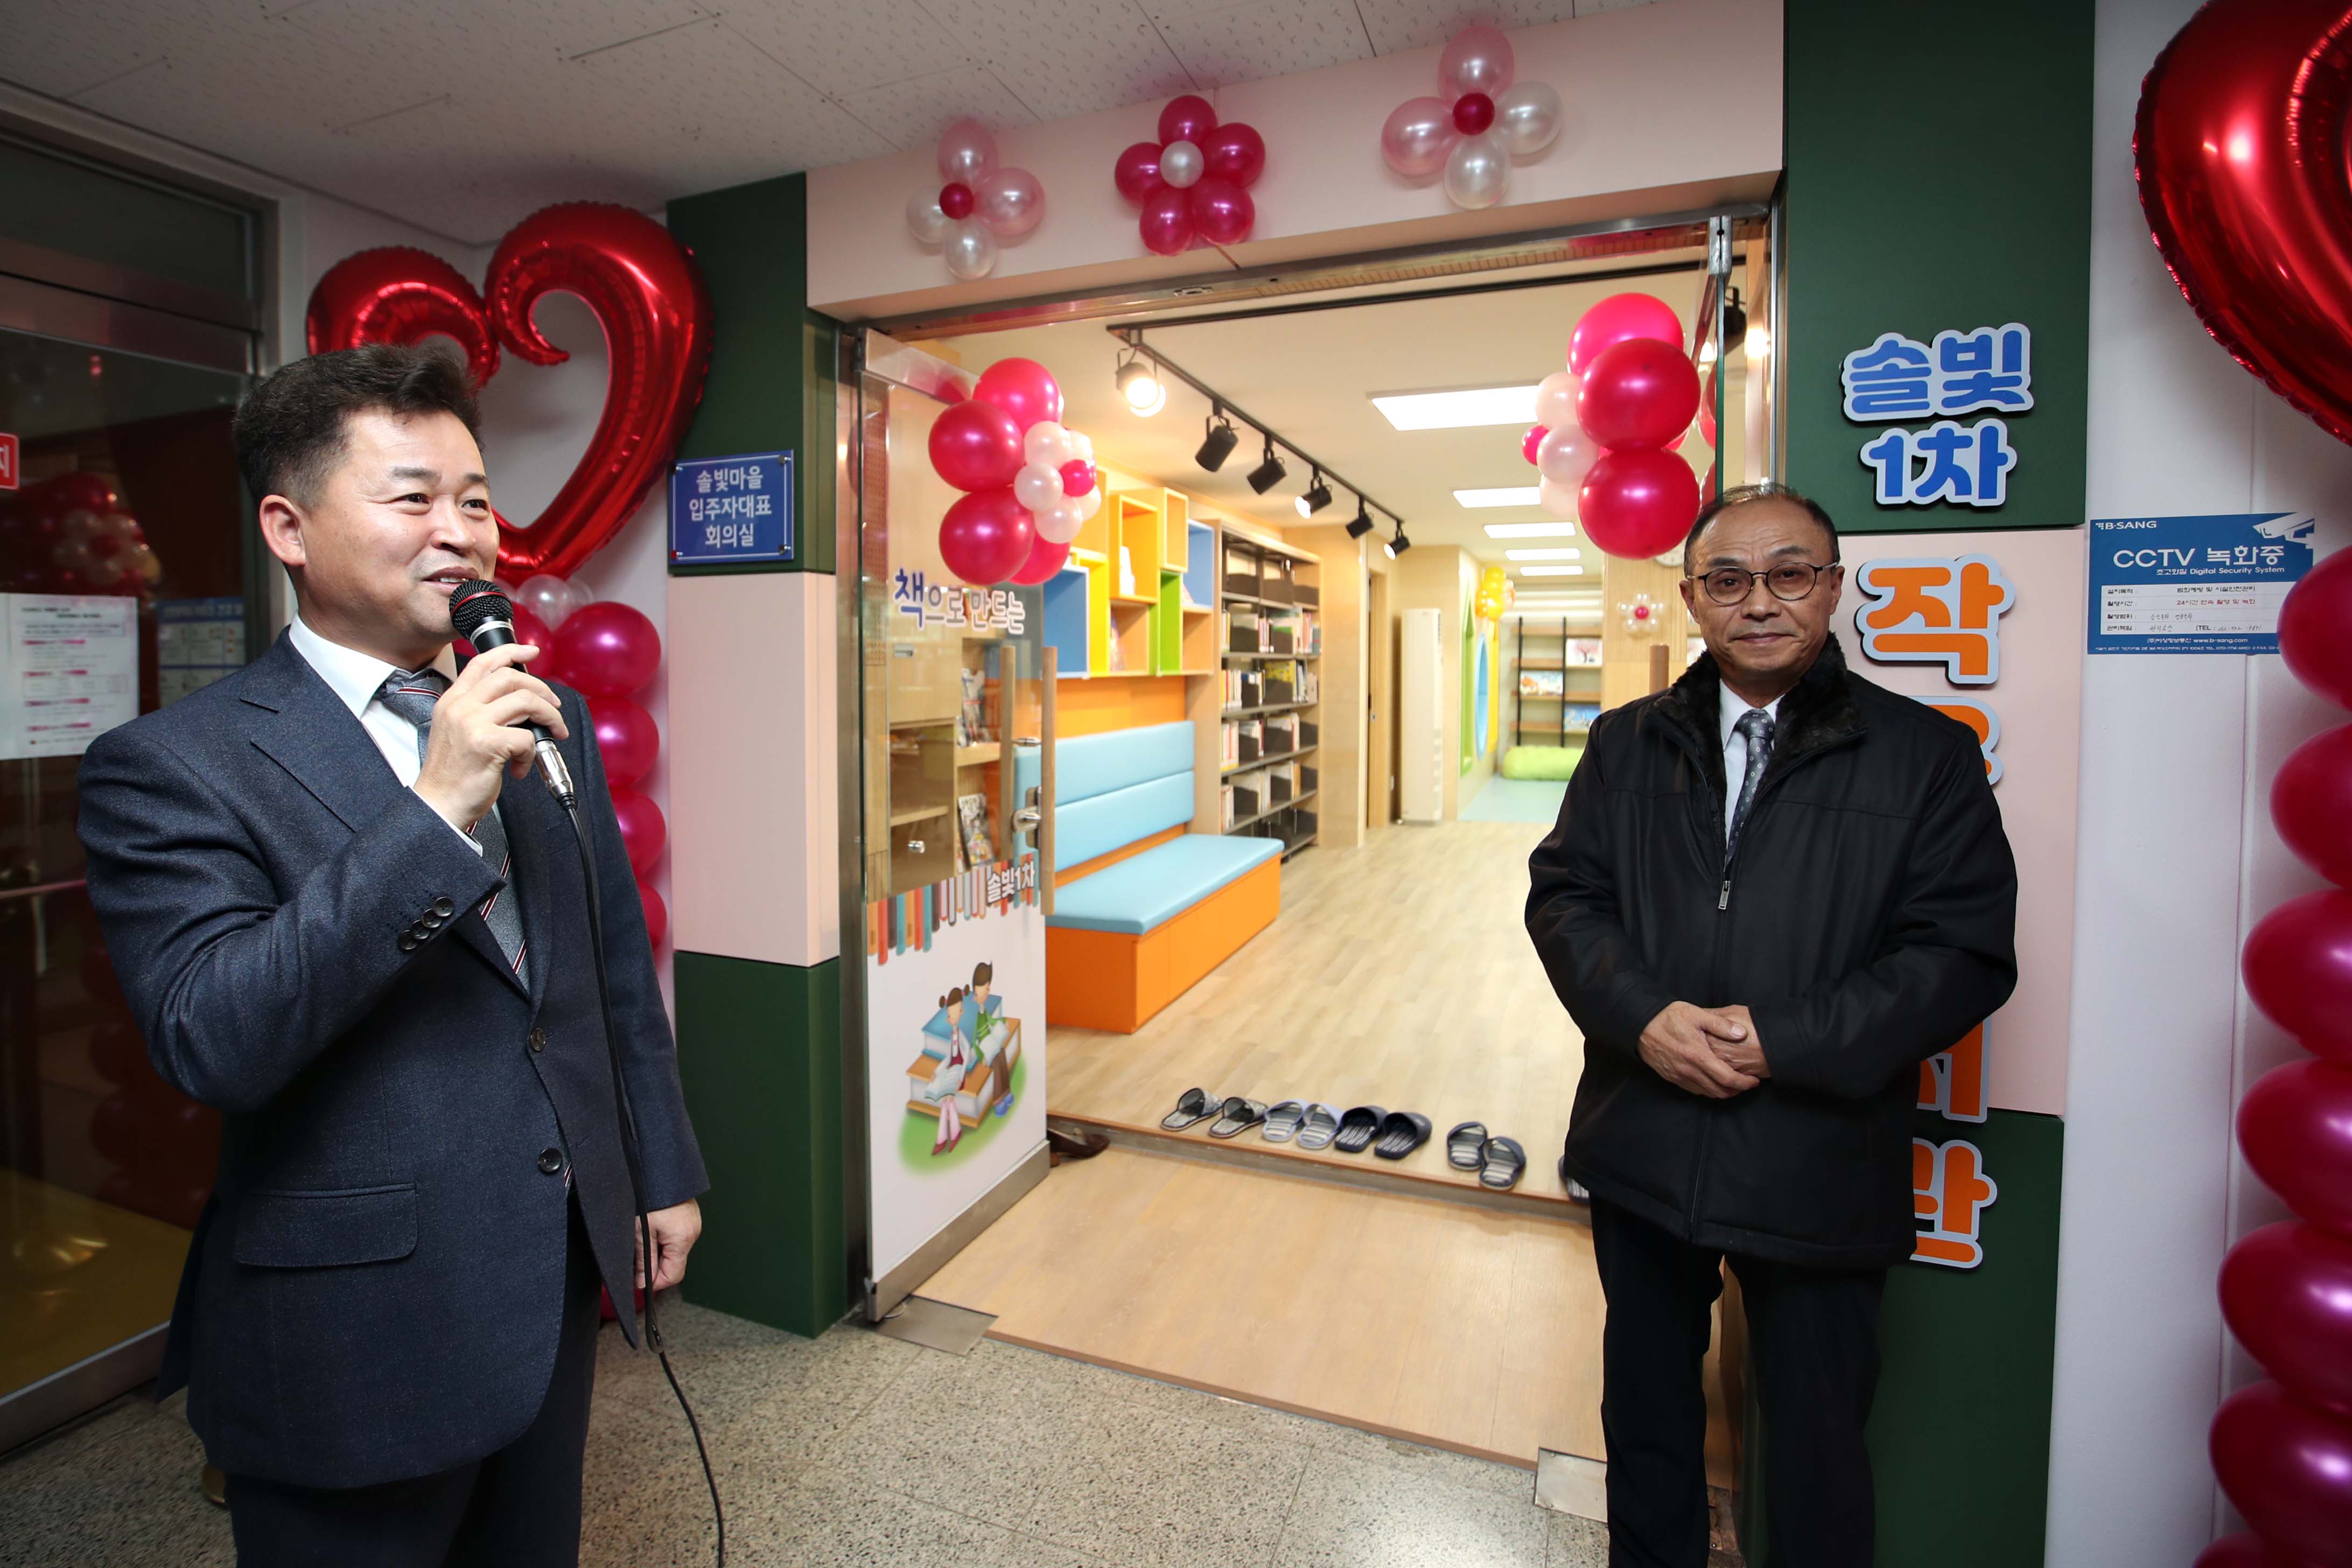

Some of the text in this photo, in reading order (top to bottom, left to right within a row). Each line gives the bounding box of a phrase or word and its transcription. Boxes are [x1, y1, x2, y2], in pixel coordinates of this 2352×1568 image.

[1849, 329, 2027, 415] 솔빛
[1867, 424, 2010, 500] 1차
[696, 465, 764, 493] 솔빛마을
[689, 494, 773, 522] 입주자대표
[705, 523, 754, 549] 회의실
[2113, 545, 2285, 568] CCTV 녹화중
[2255, 566, 2285, 575] System
[894, 568, 1025, 632] 책으로 만드는
[987, 862, 1035, 904] 솔빛1차
